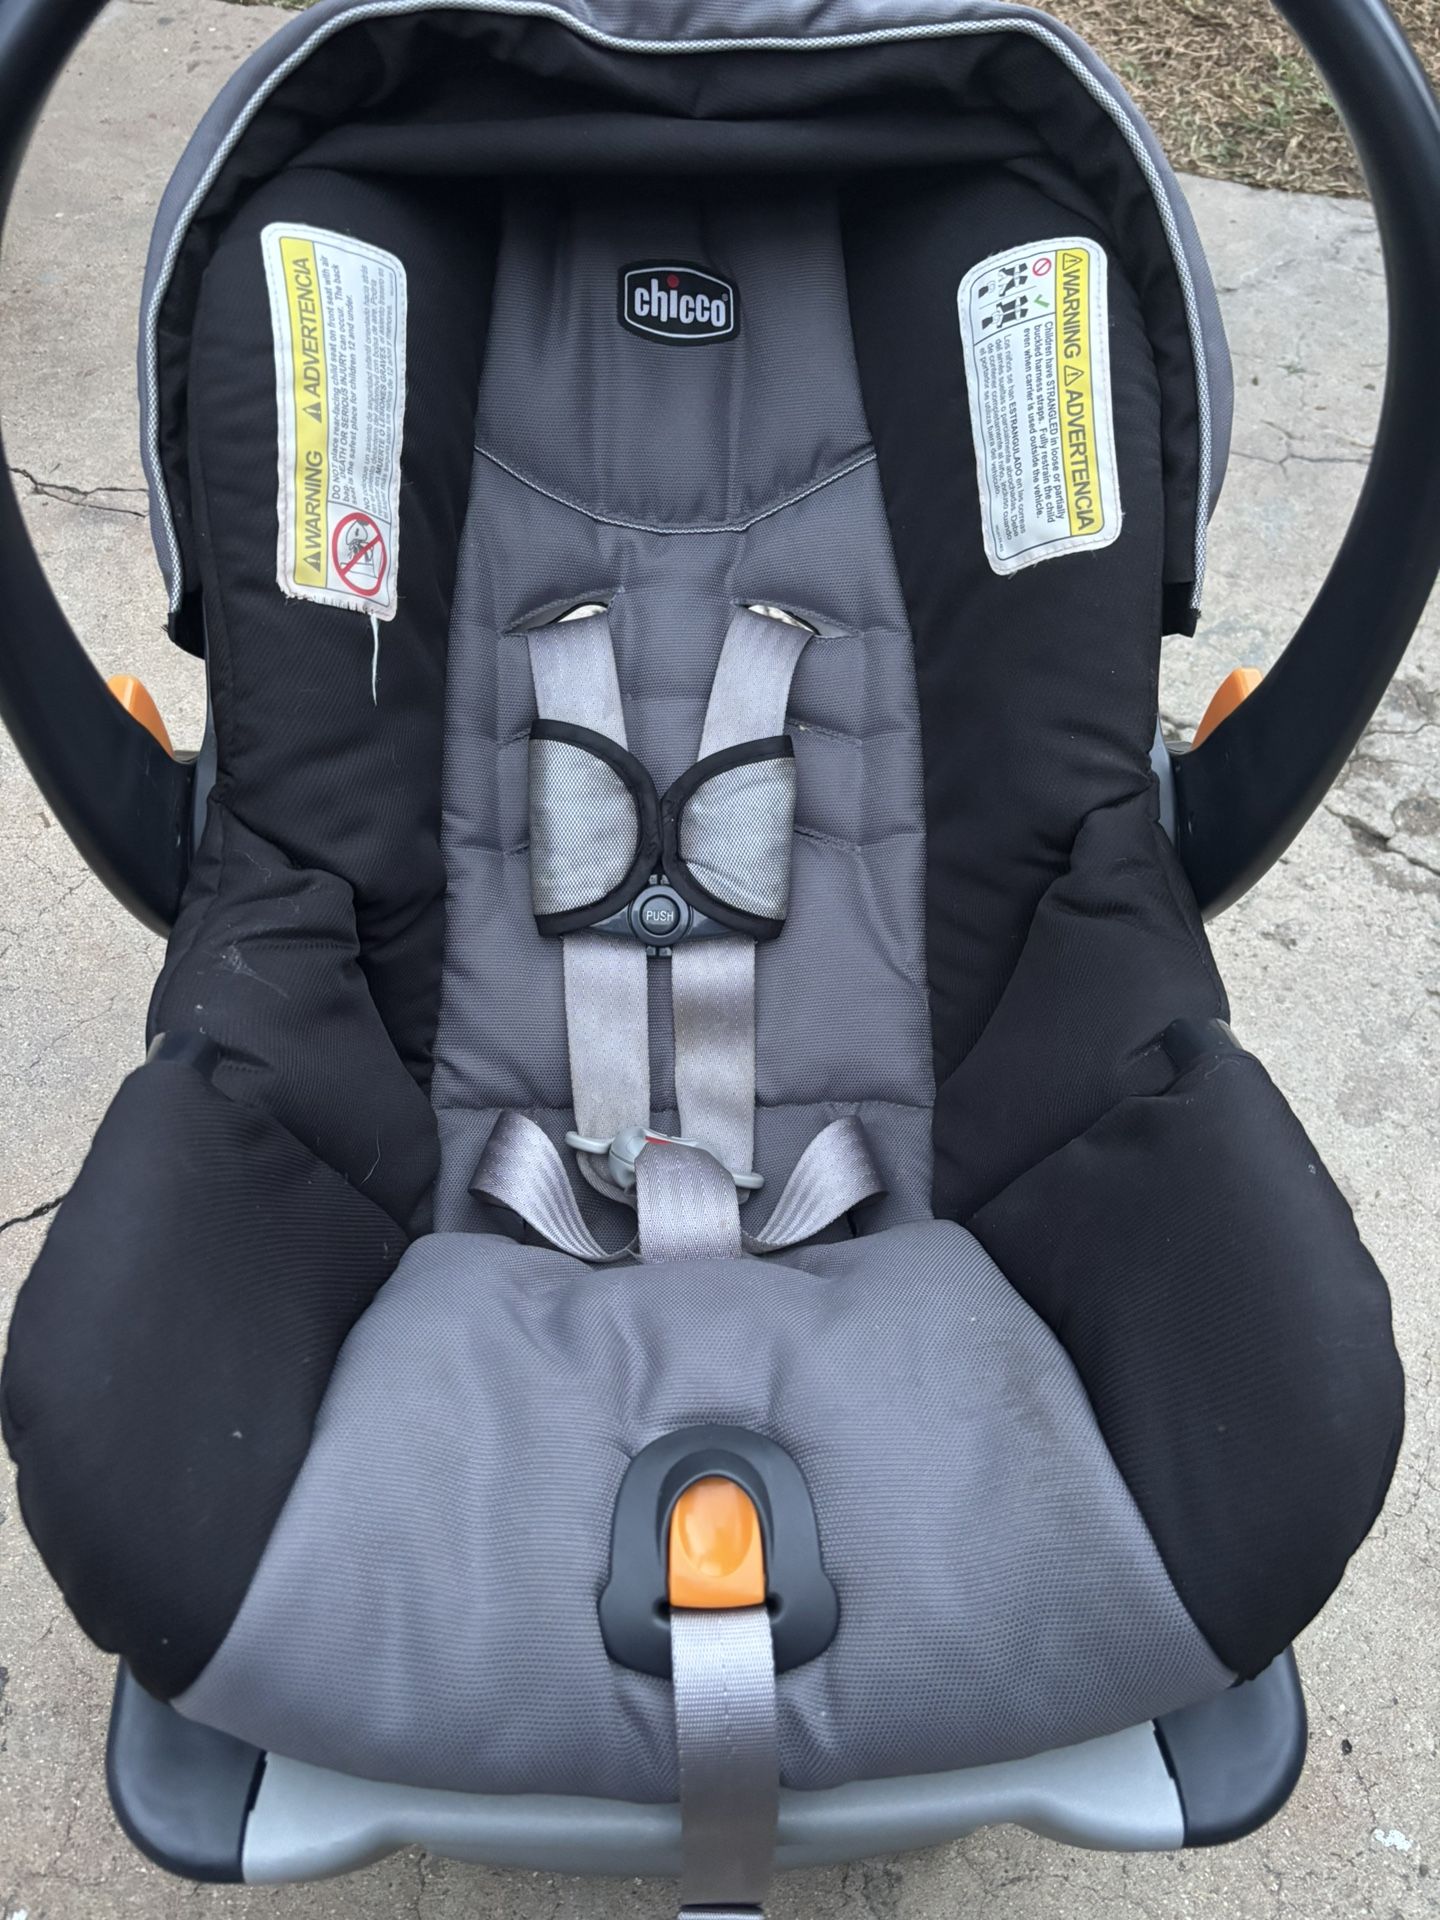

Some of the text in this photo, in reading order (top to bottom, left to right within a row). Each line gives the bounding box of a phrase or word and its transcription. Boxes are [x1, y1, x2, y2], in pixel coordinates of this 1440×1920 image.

[634, 275, 727, 327] chicco
[1024, 350, 1032, 372] when
[1025, 373, 1033, 401] carrier
[1063, 270, 1094, 530] WARNING ADVERTENCIA
[293, 258, 323, 550] WARNING ADVERTENCIA
[1028, 402, 1035, 411] is
[1028, 413, 1037, 434] used
[1034, 324, 1055, 523] buckled harness straps. Fully restrain the child
[1045, 322, 1065, 519] Children have STRANGLED in loose or partially
[1009, 402, 1022, 476] ESTRANGULADO
[1030, 436, 1040, 467] outside
[1033, 469, 1041, 483] the
[1034, 484, 1044, 518] vehicle.
[646, 910, 674, 921] PUSH
